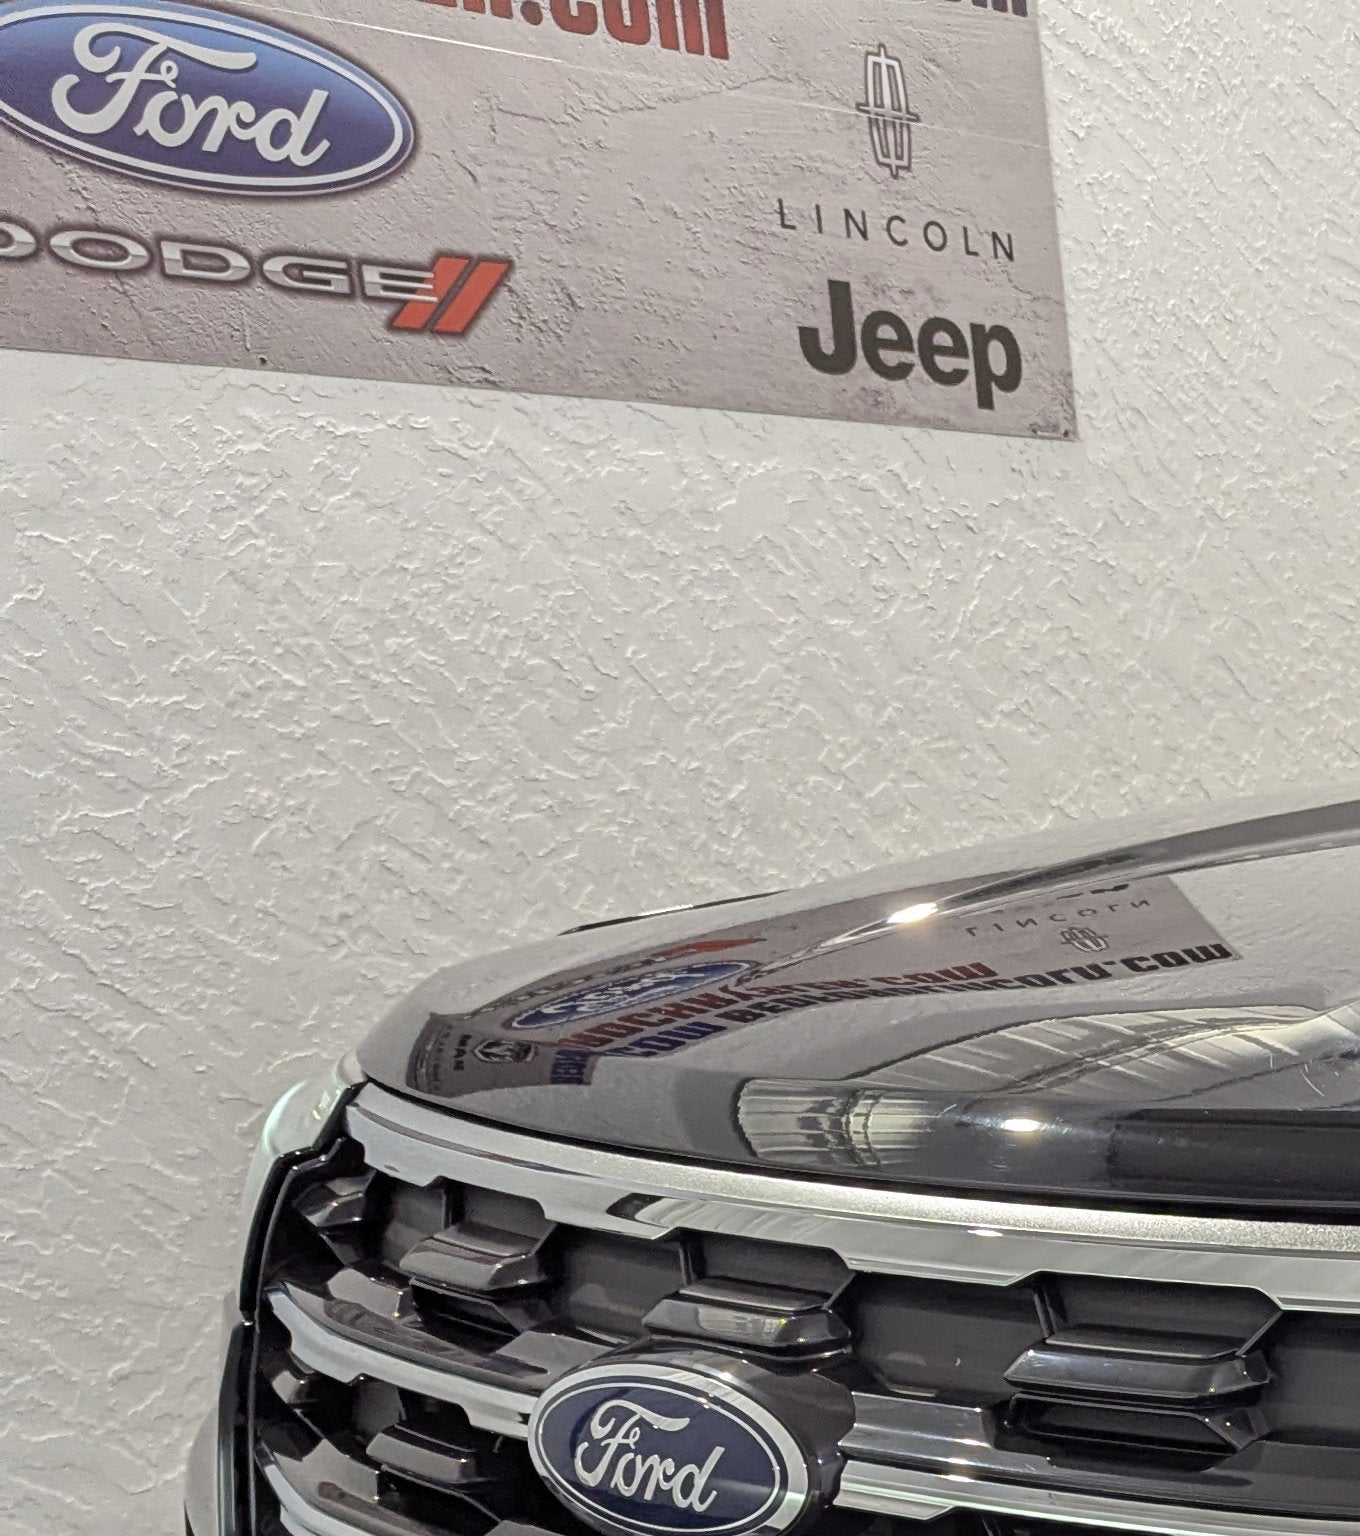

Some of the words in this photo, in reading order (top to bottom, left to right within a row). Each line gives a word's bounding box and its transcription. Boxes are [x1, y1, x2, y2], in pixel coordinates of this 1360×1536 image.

[52, 20, 330, 169] Ford
[777, 198, 1016, 263] LINCOLN
[798, 279, 1023, 409] Jeep
[573, 1399, 726, 1513] Ford
